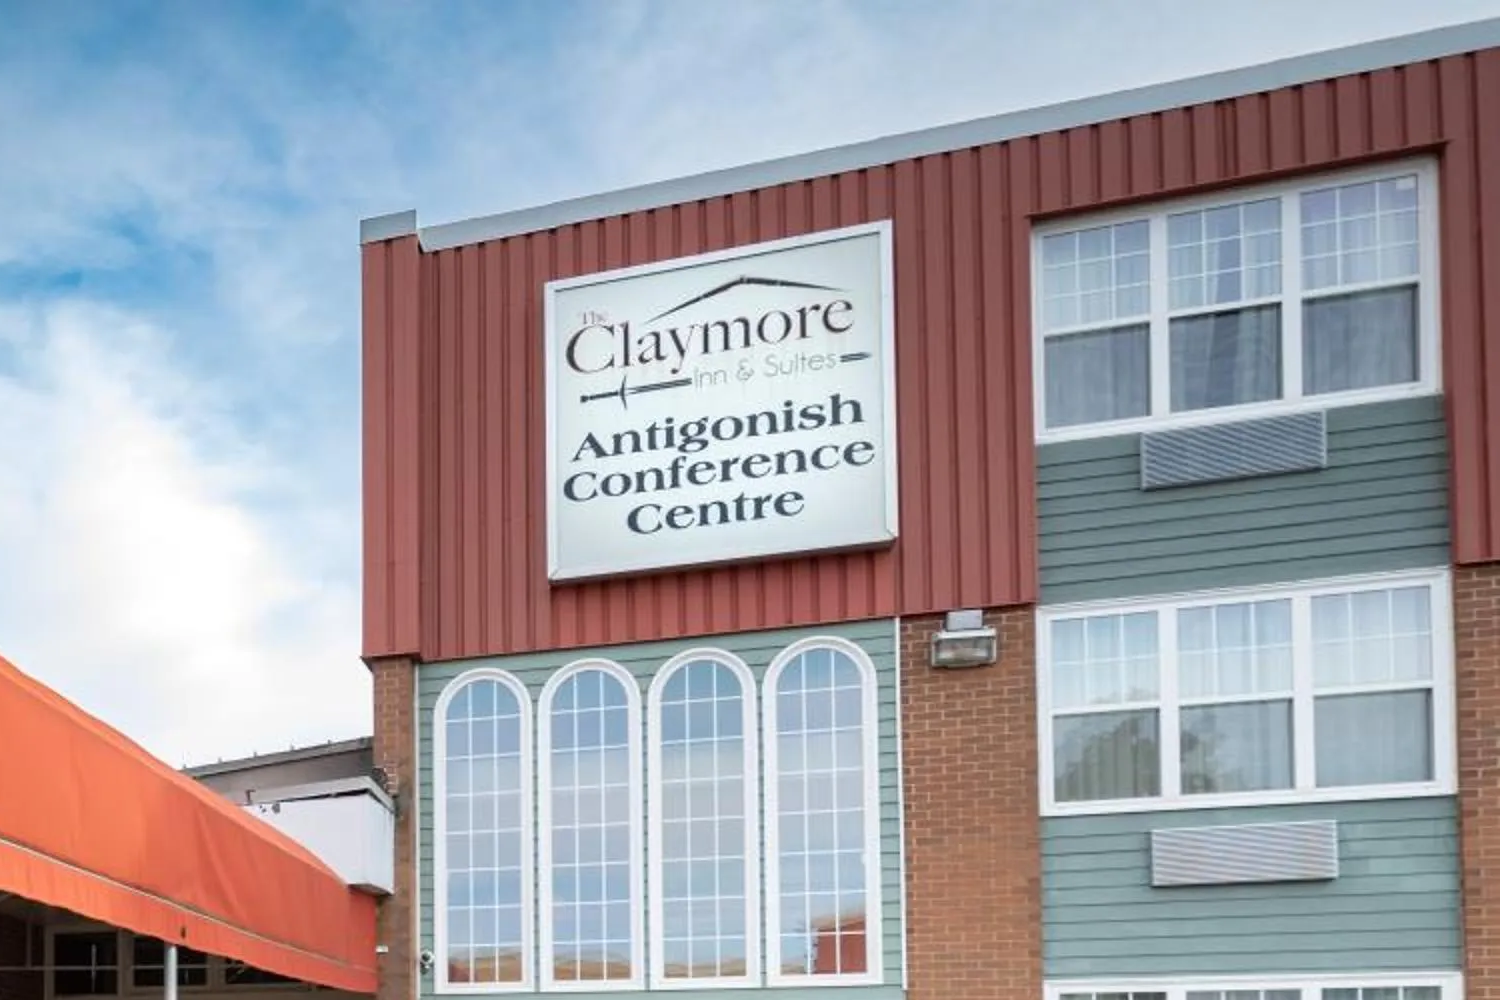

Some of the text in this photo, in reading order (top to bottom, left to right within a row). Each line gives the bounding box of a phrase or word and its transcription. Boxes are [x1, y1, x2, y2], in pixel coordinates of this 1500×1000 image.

[565, 298, 854, 375] Claymore
[694, 351, 837, 389] Inn & Suites
[572, 392, 866, 462] Antigonish
[563, 438, 877, 503] Conference
[626, 489, 806, 535] Centre
